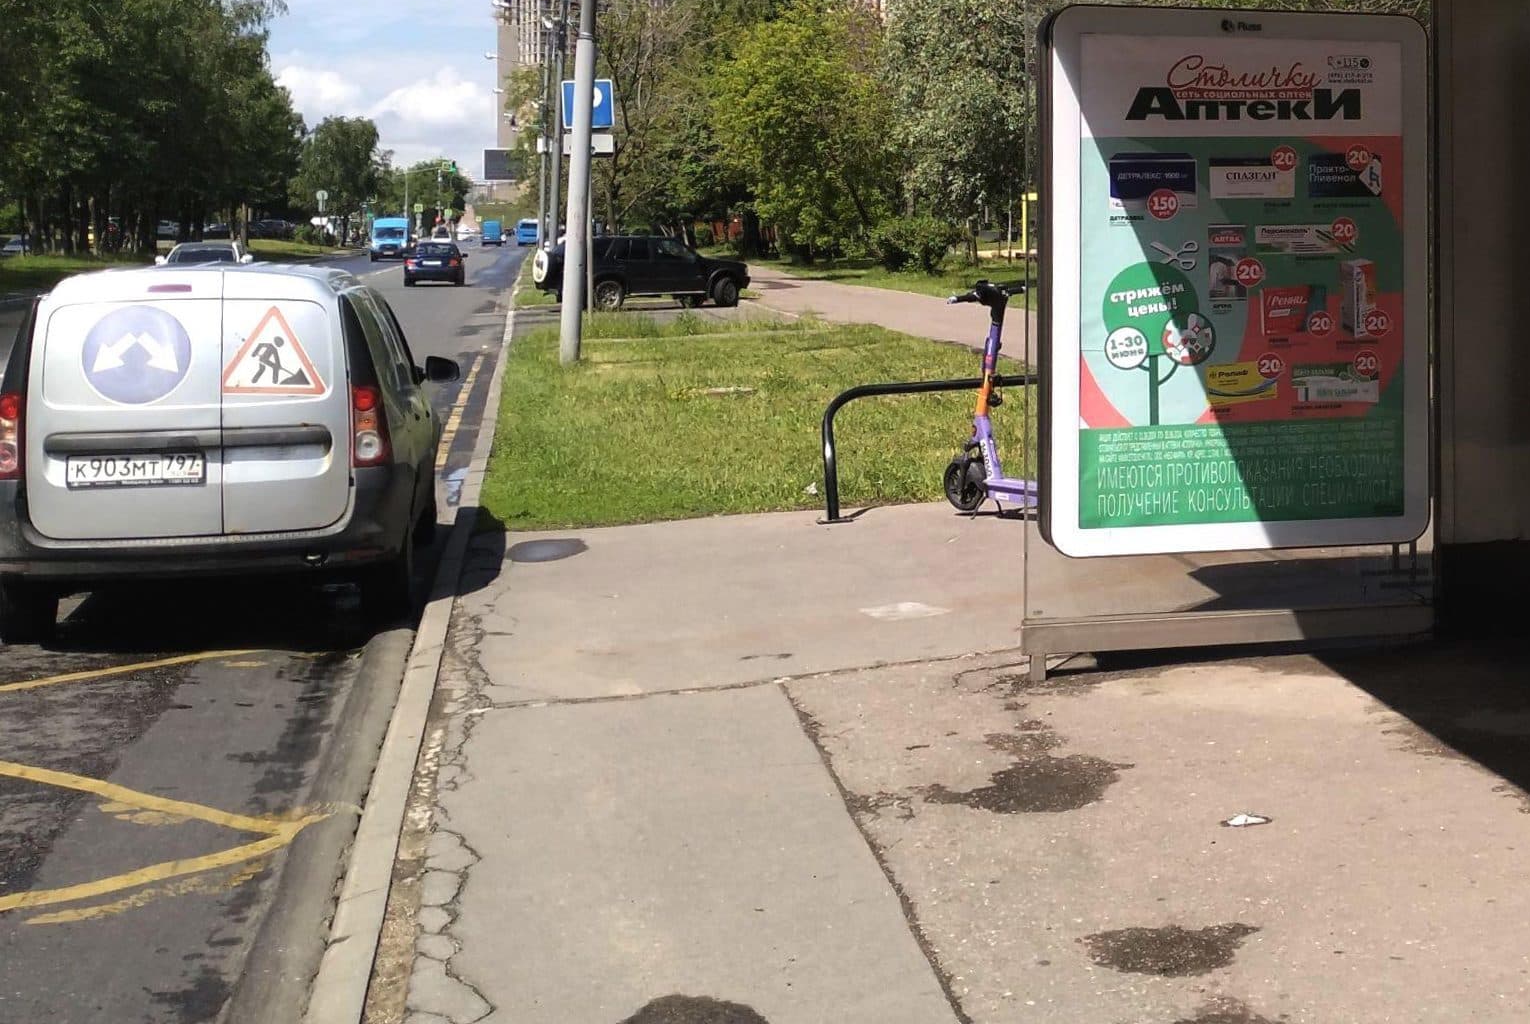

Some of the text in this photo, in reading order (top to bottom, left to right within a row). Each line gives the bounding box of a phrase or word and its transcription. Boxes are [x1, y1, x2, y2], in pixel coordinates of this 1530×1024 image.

[1237, 20, 1263, 33] Russ
[1167, 54, 1322, 89] Столички
[1203, 89, 1277, 100] социальных
[1278, 88, 1313, 100] аптек
[1225, 171, 1276, 182] СПАЗГАН
[1110, 281, 1185, 303] стрижём
[1127, 297, 1178, 318] цены!
[1110, 335, 1143, 350] 1-30
[75, 455, 197, 479] К903МТ 797
[1097, 463, 1163, 489] ИМЕЮТСЯ
[1098, 489, 1180, 518] ПОЛУЧЕНИЕ
